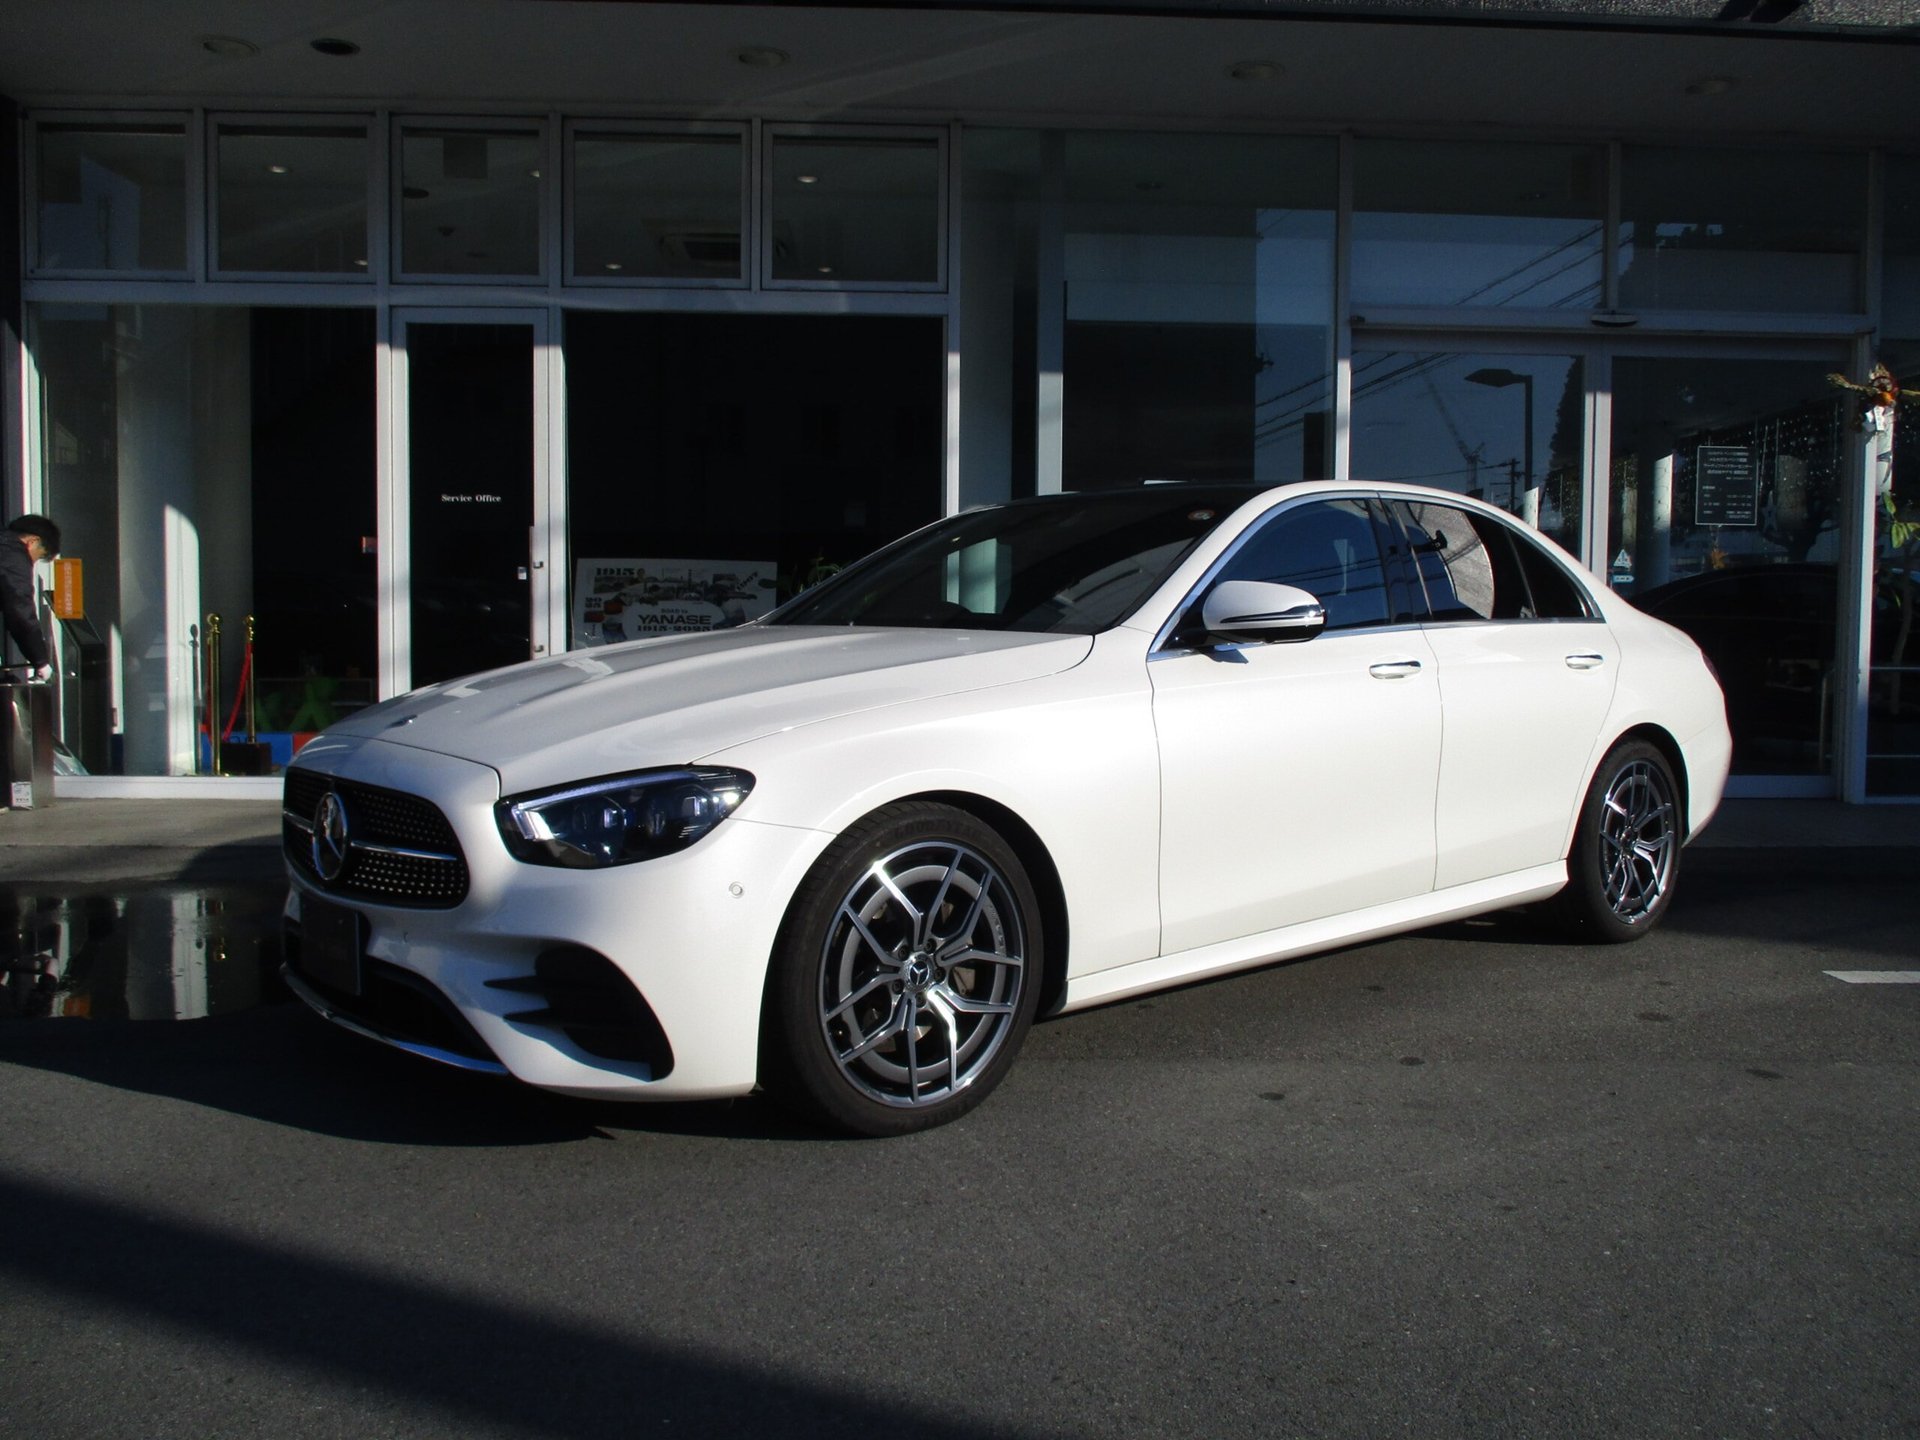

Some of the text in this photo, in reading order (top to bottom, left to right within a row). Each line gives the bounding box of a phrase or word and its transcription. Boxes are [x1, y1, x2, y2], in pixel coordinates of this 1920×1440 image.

[441, 494, 502, 503] Service Office
[638, 614, 712, 625] YANASE
